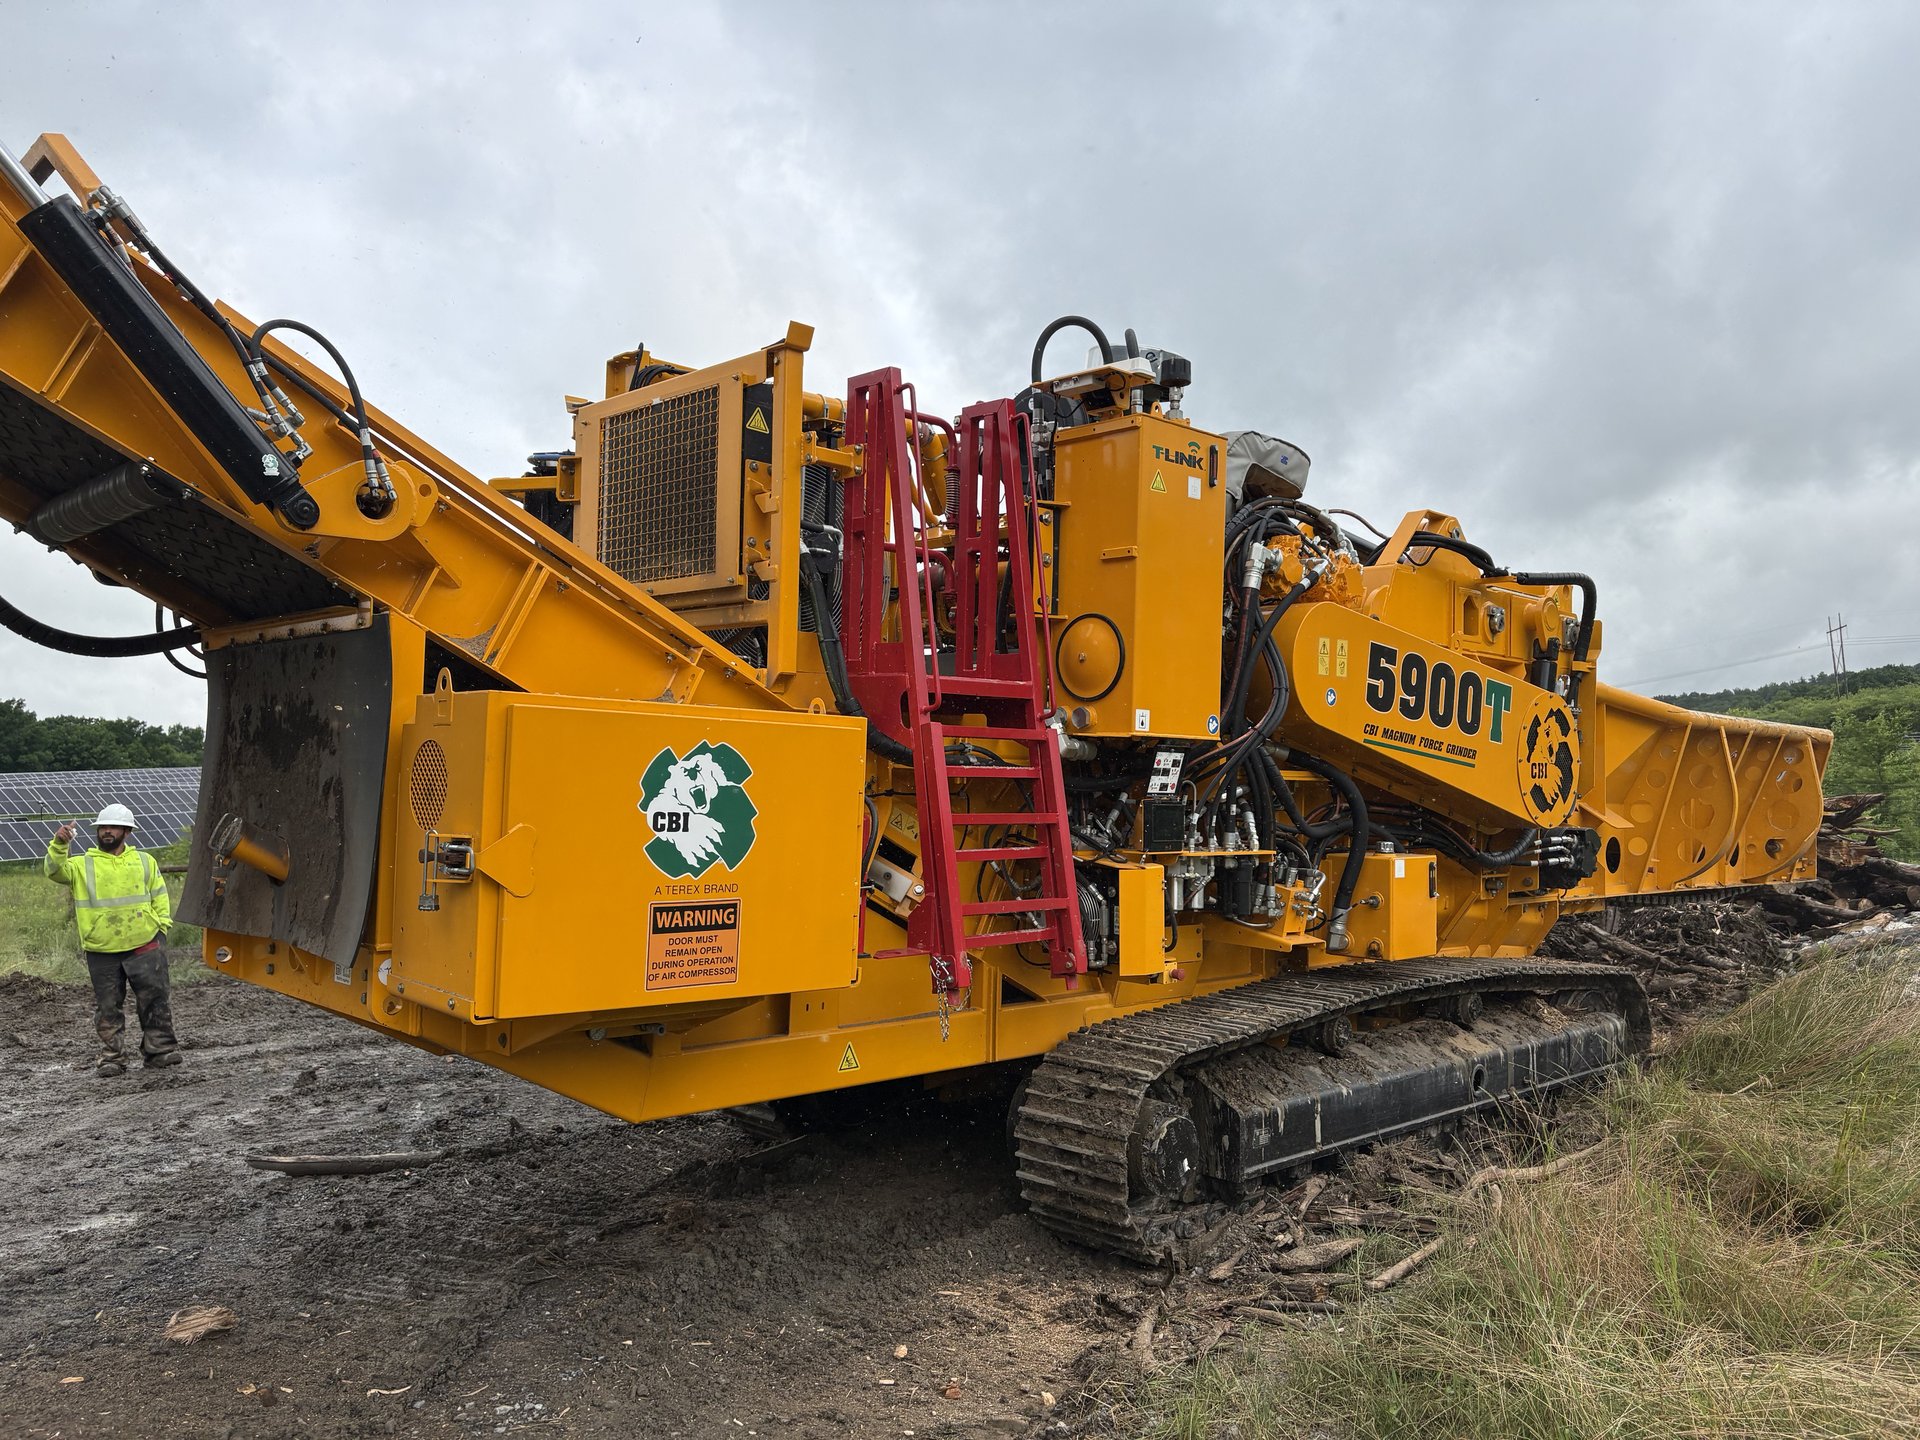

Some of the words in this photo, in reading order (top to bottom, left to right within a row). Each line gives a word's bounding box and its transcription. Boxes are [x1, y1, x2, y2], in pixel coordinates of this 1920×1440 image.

[1365, 640, 1513, 744] 5900T
[1363, 723, 1379, 737] CBI
[1381, 727, 1416, 746] MAGNUM
[1418, 736, 1444, 752] FORCE
[1445, 744, 1478, 760] GRINDER
[1530, 762, 1548, 779] CBI
[652, 811, 690, 833] CBI
[654, 886, 662, 895] A
[665, 885, 700, 895] TEREX
[703, 883, 739, 893] BRAND
[656, 907, 735, 929] WARNING
[668, 937, 693, 946] DOOR
[695, 935, 719, 944] MUST
[665, 948, 698, 957] REMAIN
[700, 946, 722, 954] OPEN
[651, 960, 685, 970] DURING
[687, 956, 734, 967] OPERATION
[648, 973, 660, 982] OF
[661, 971, 676, 980] AIR
[678, 967, 736, 979] COMPRESSOR
